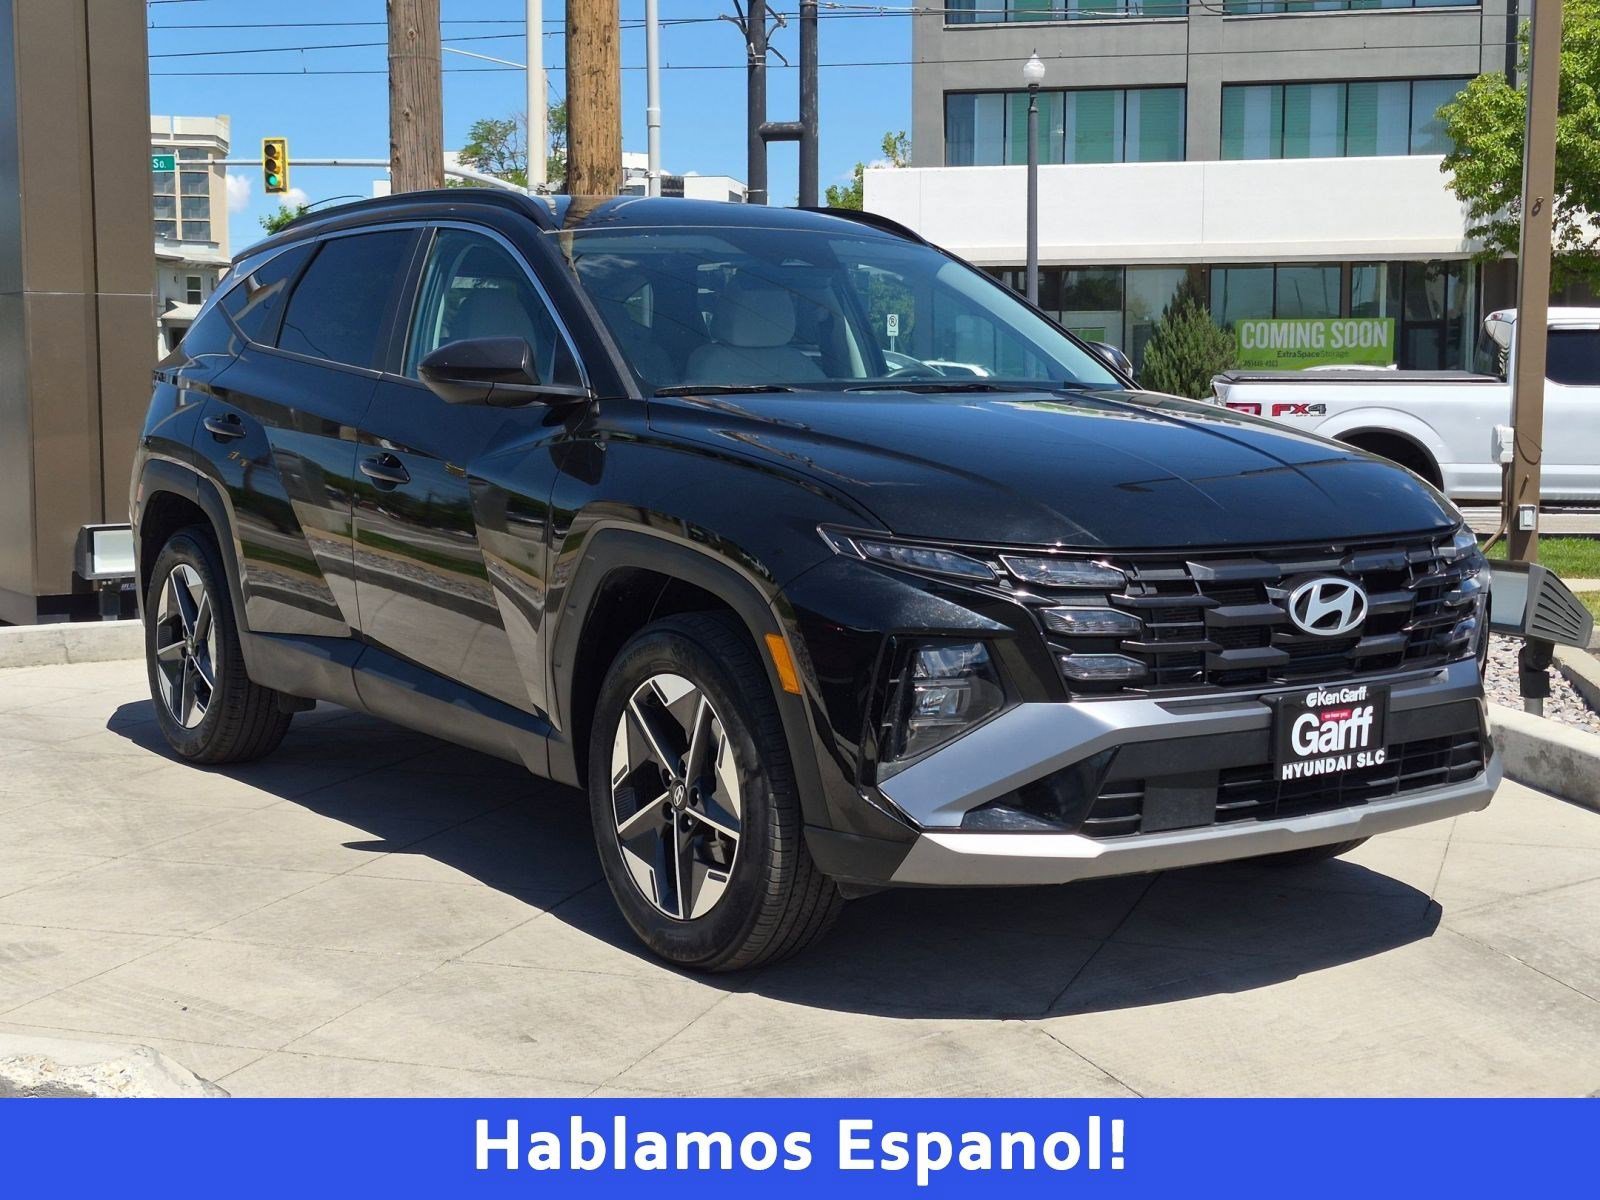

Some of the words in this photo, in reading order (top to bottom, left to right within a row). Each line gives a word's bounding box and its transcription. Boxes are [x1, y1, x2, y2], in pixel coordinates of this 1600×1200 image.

[153, 158, 167, 169] So.
[1241, 321, 1325, 349] COMING
[1330, 320, 1388, 348] SOON
[1271, 403, 1327, 417] FX4
[1291, 705, 1374, 757] Garff
[1282, 755, 1352, 780] HYUNDAI
[1356, 749, 1385, 768] SLC
